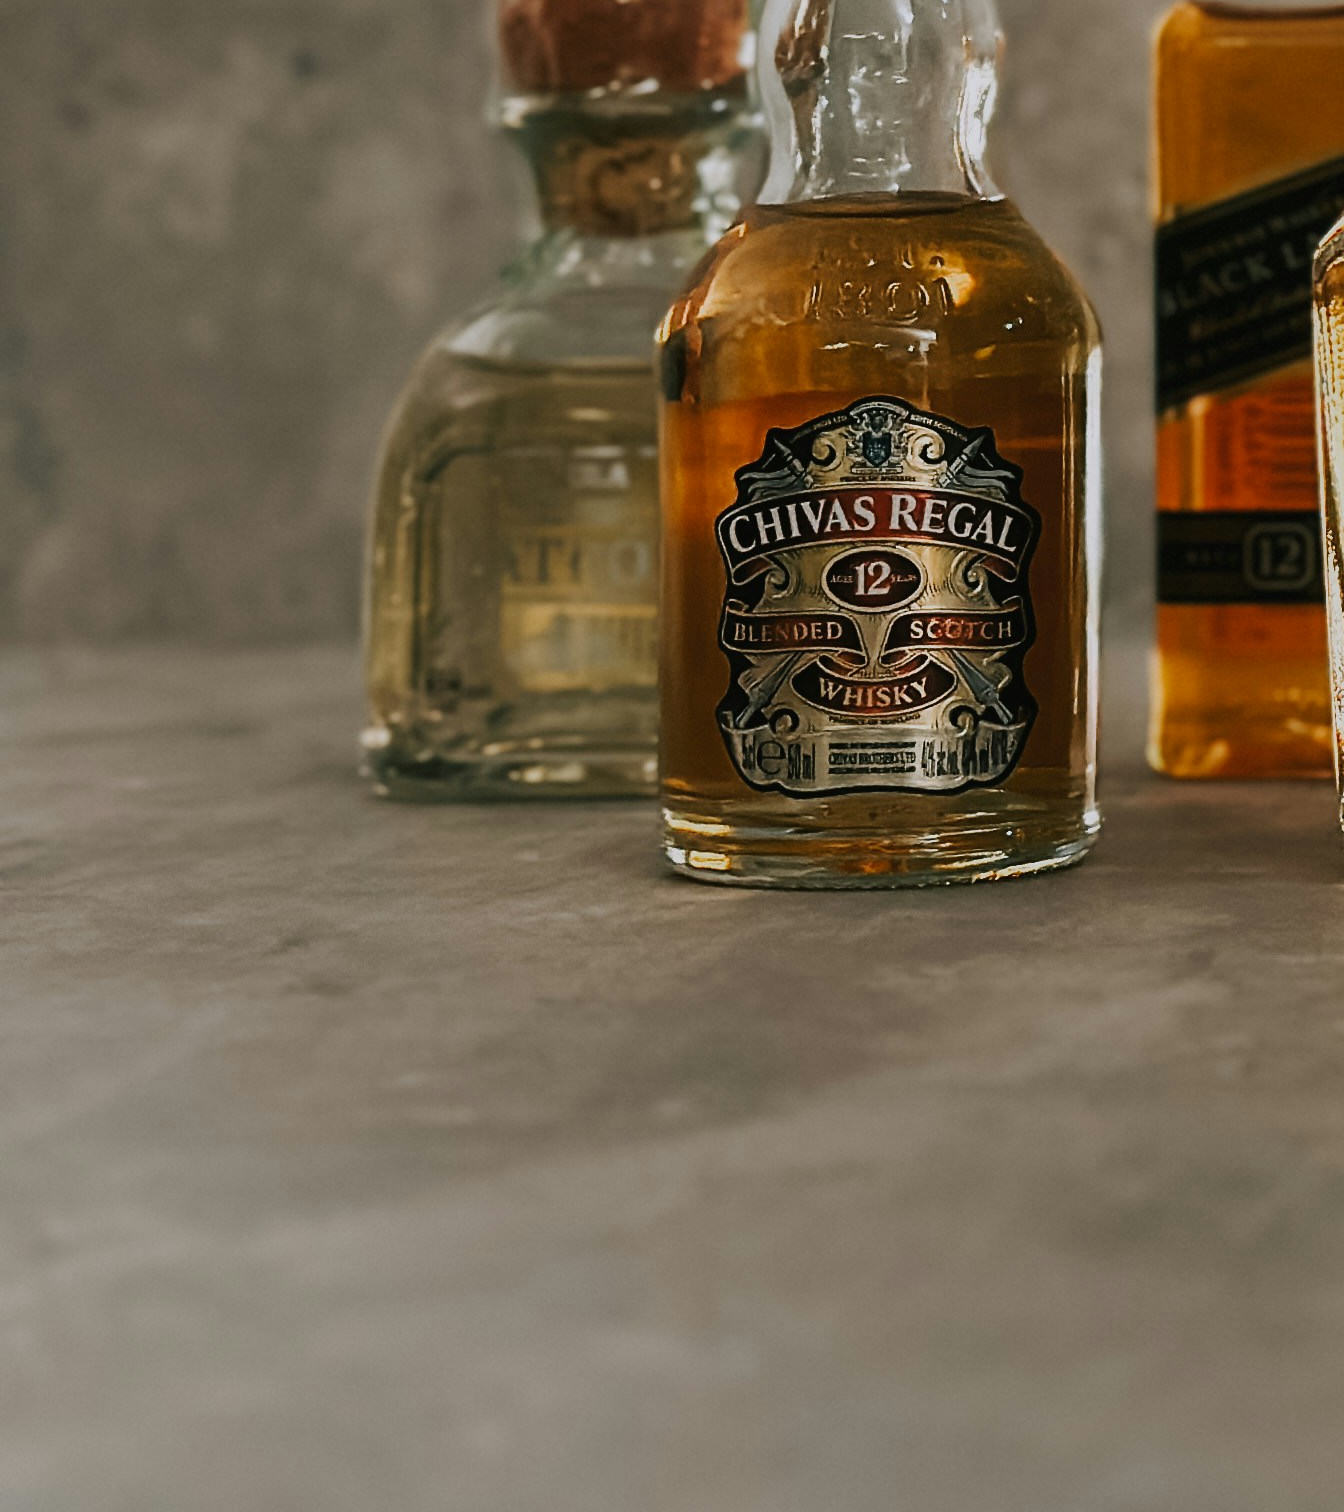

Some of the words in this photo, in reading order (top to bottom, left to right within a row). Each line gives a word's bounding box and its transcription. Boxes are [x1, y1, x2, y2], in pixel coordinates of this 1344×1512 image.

[728, 494, 876, 554] CHIVAS
[889, 493, 1017, 553] REGAL
[1258, 536, 1302, 578] 12
[853, 560, 893, 597] 12
[733, 620, 844, 643] BLENDED
[910, 618, 1013, 639] SCOTCH
[818, 675, 929, 708] WHISKY
